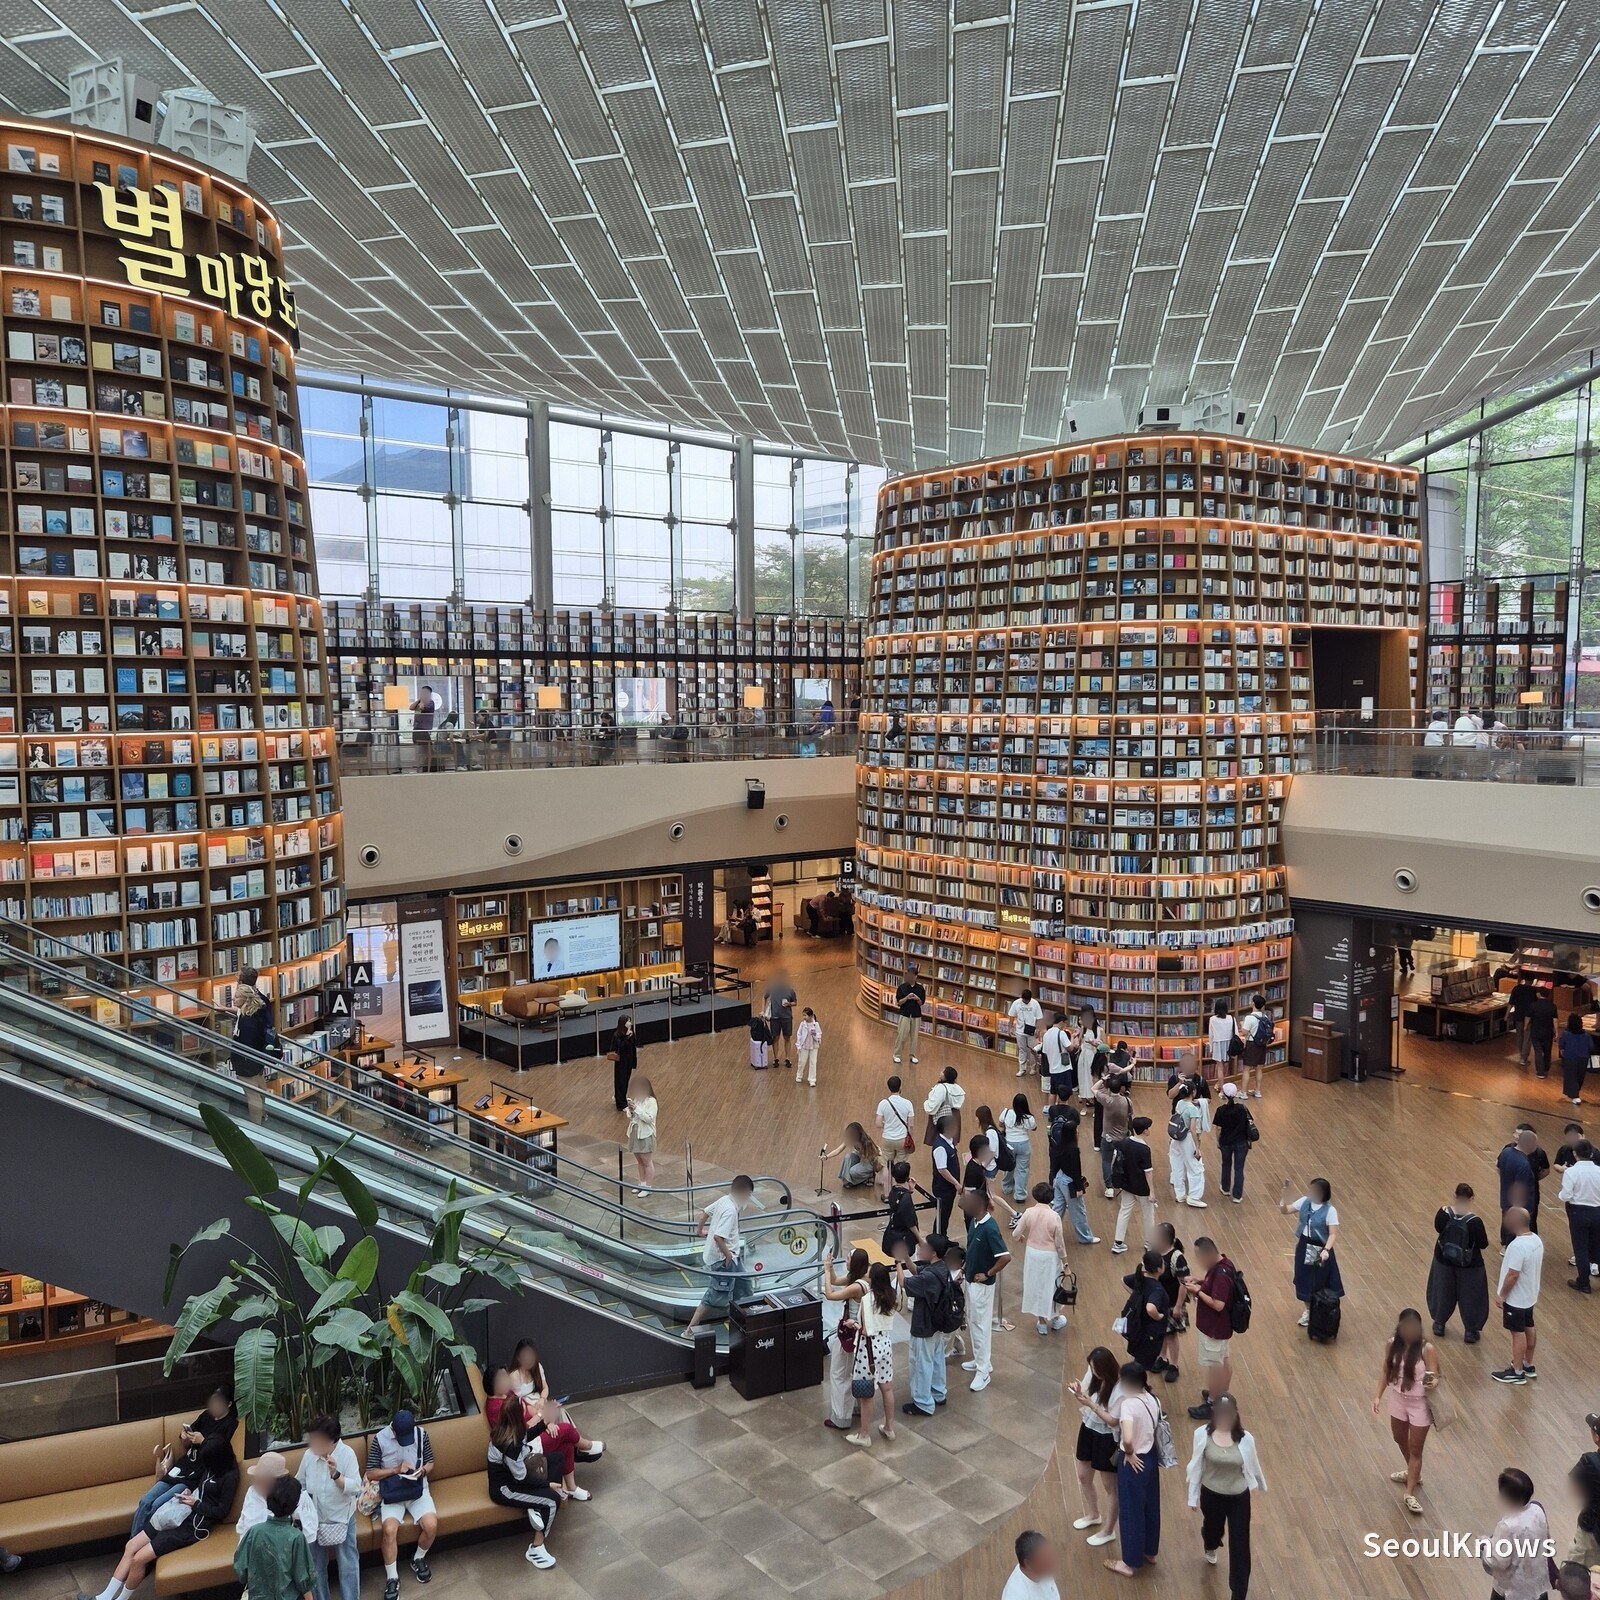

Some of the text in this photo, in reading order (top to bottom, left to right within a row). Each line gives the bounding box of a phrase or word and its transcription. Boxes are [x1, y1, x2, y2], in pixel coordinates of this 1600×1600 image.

[844, 861, 853, 873] B
[1055, 899, 1064, 913] B
[353, 965, 370, 984] A
[332, 994, 349, 1014] A
